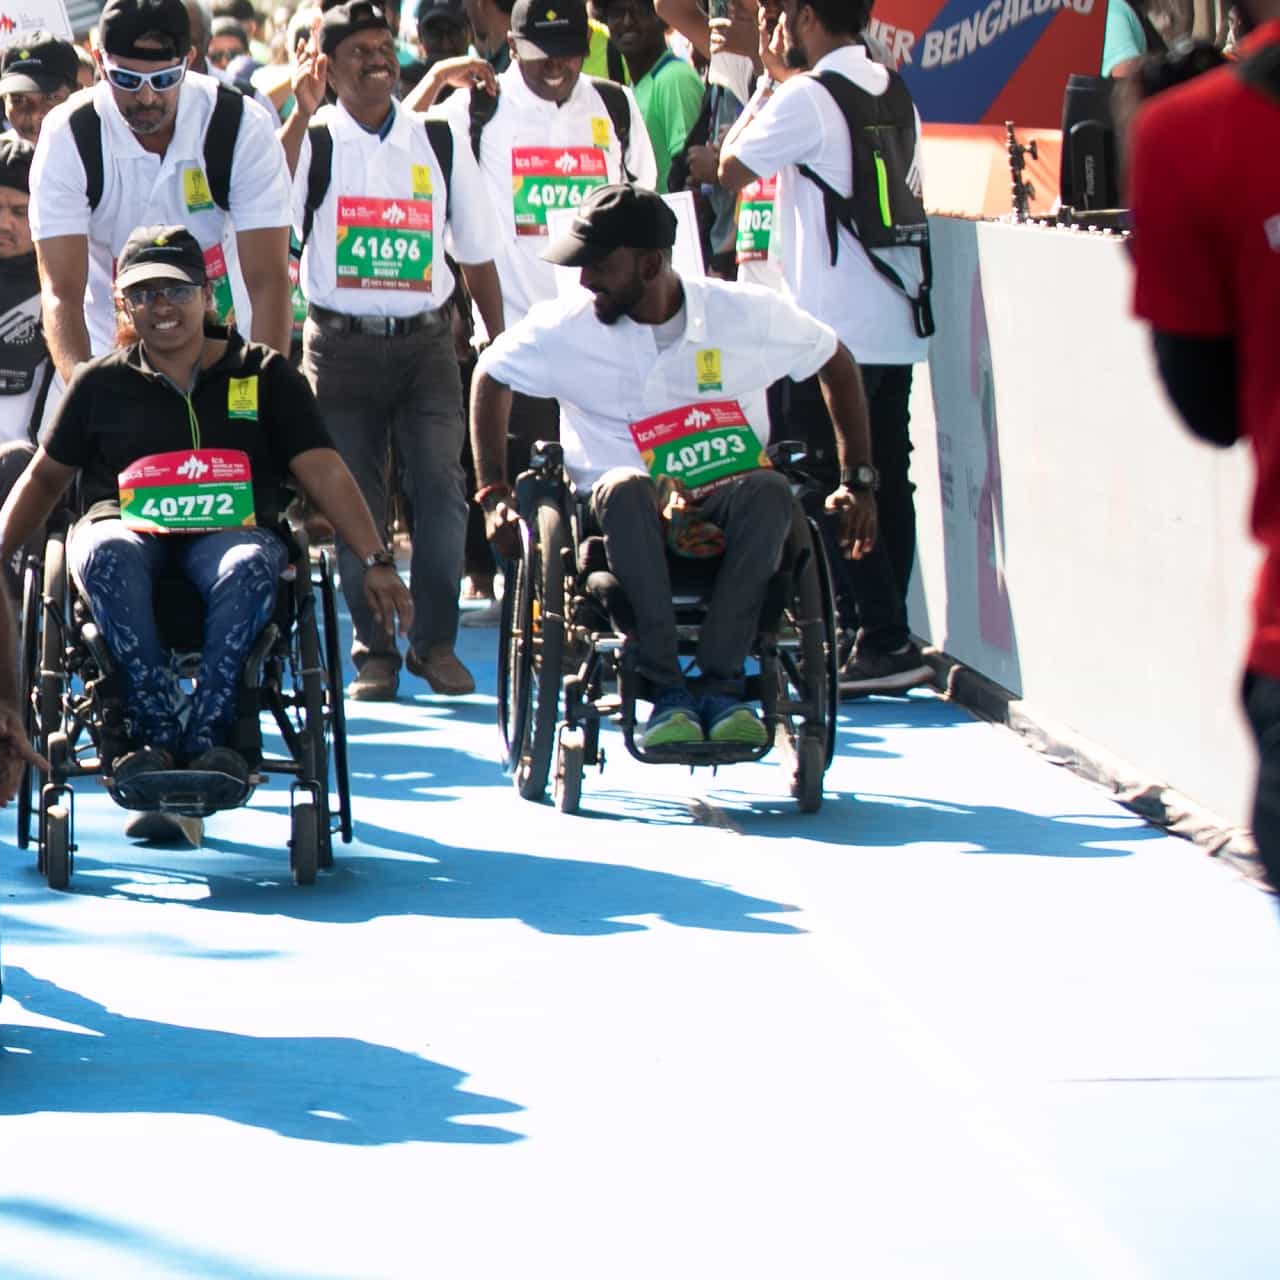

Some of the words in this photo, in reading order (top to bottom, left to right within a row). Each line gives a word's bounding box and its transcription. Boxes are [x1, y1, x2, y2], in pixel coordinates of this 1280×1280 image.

[351, 235, 421, 262] 41696
[665, 434, 747, 473] 40793
[141, 492, 235, 517] 40772
